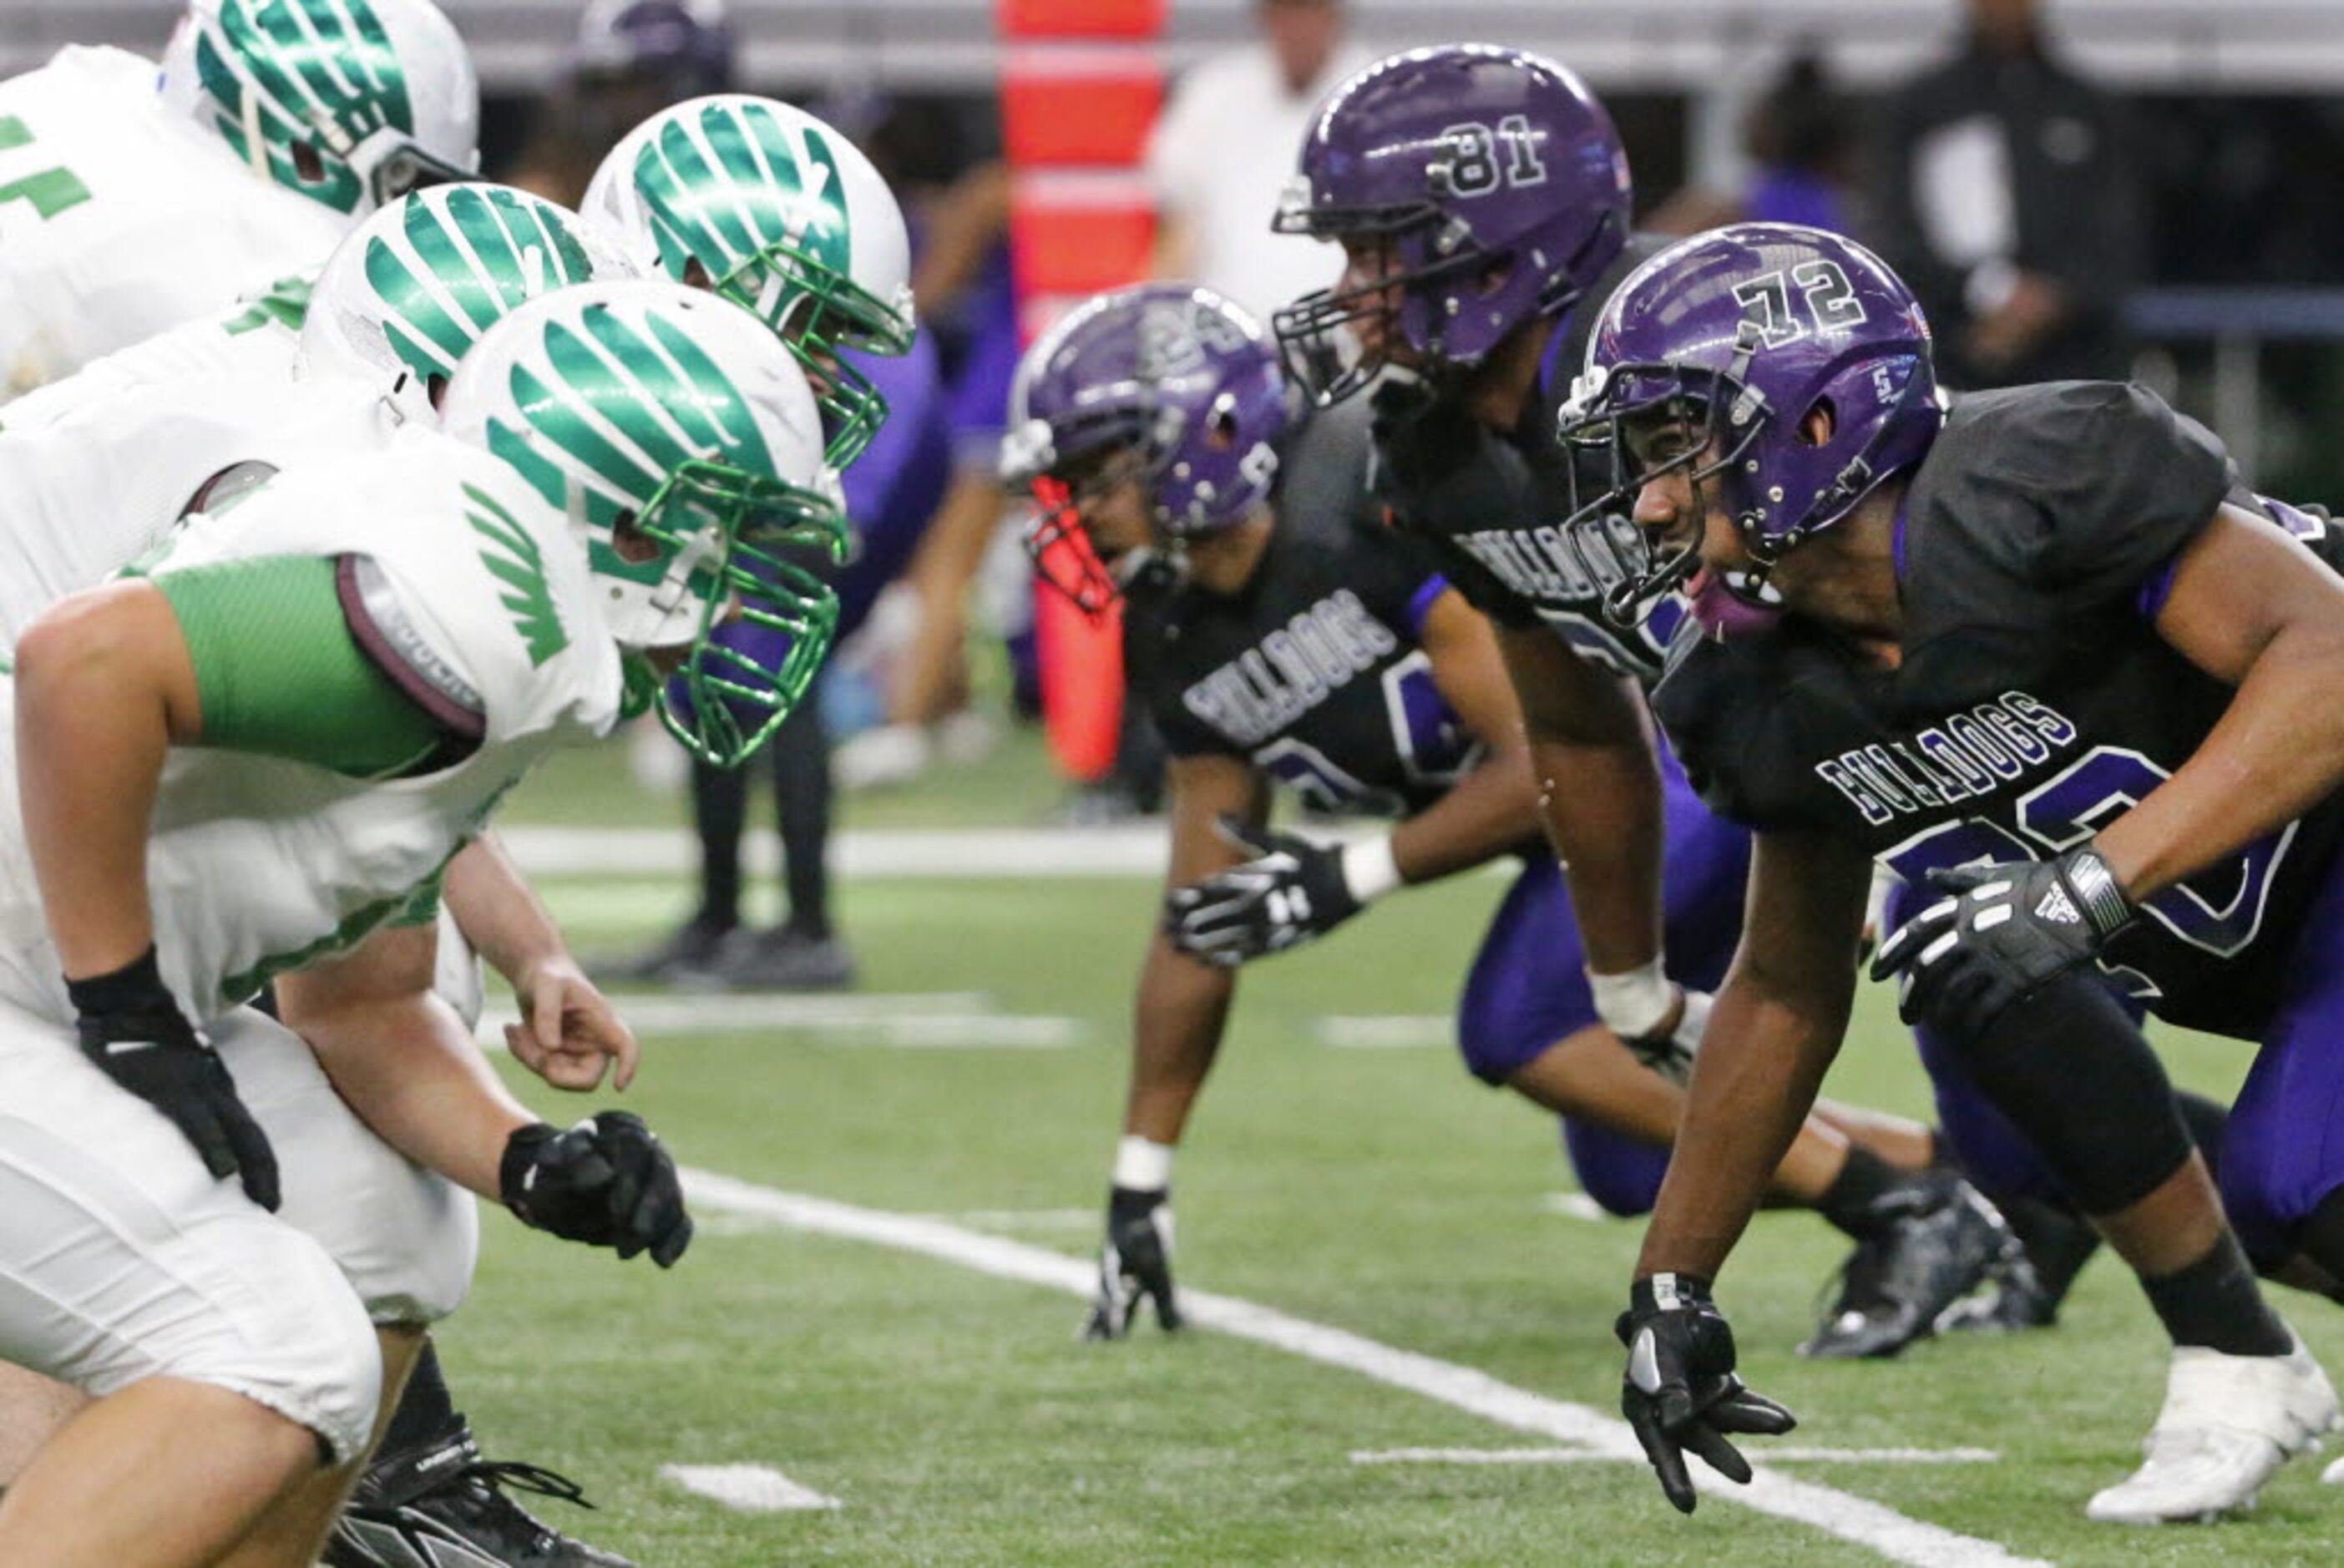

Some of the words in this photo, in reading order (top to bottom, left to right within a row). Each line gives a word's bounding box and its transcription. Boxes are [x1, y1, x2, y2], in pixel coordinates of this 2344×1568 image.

[1440, 114, 1547, 200] 81
[1731, 260, 1867, 351] 72
[1815, 690, 2078, 826] BULLDOGS
